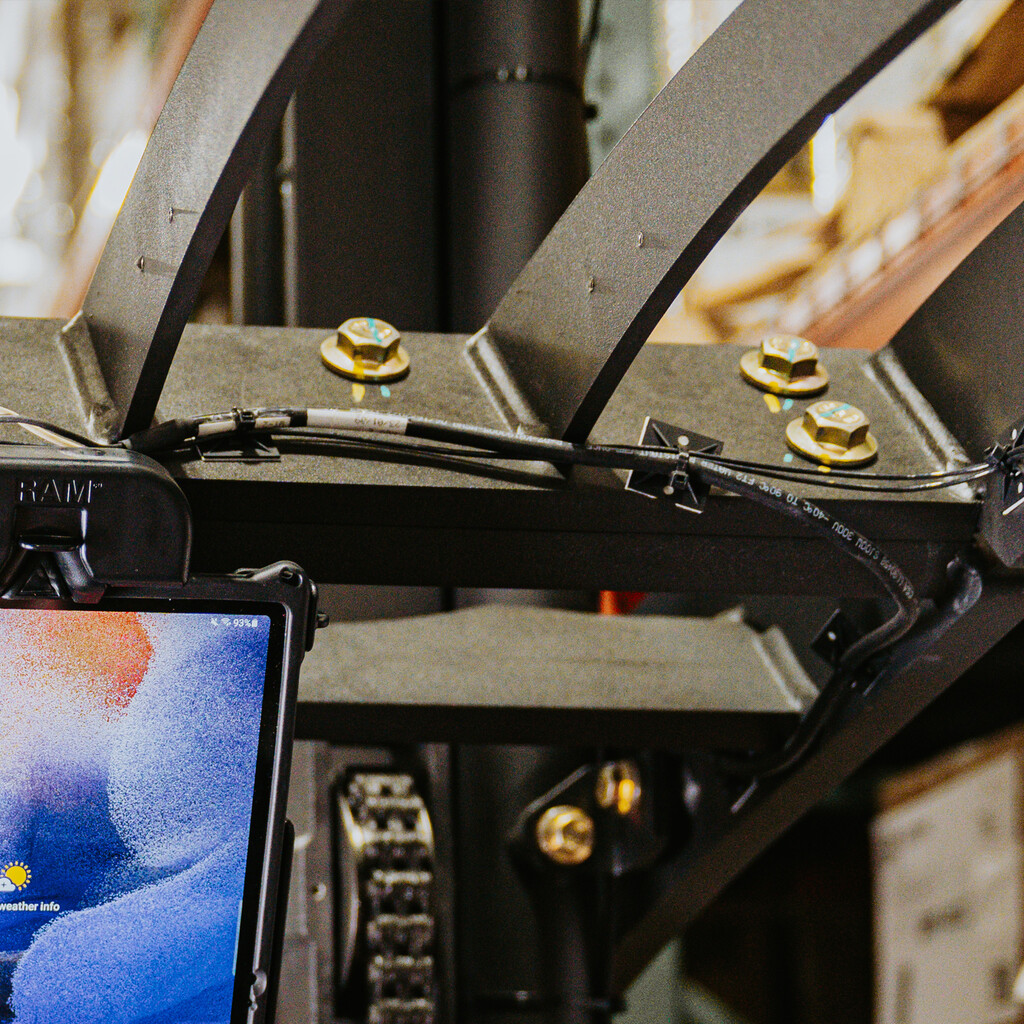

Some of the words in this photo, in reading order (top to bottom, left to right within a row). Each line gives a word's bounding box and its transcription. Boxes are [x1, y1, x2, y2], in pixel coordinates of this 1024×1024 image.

[19, 478, 93, 504] RAM
[233, 618, 252, 628] 93%
[40, 901, 60, 911] info
